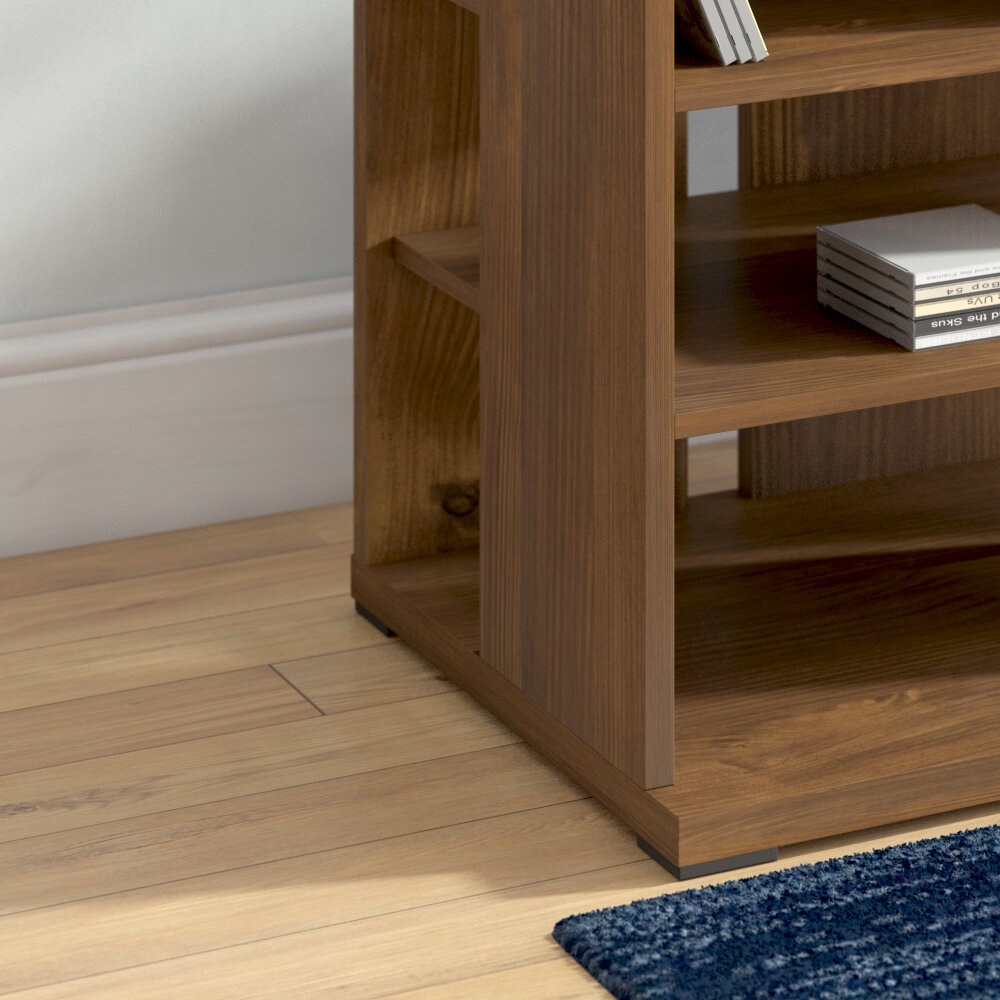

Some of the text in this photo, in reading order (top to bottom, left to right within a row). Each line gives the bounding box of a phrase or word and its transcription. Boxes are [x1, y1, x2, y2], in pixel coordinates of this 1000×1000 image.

[974, 266, 990, 274] and
[945, 287, 963, 295] 54
[966, 295, 993, 306] UVs
[930, 317, 963, 329] Skus
[967, 313, 987, 323] the
